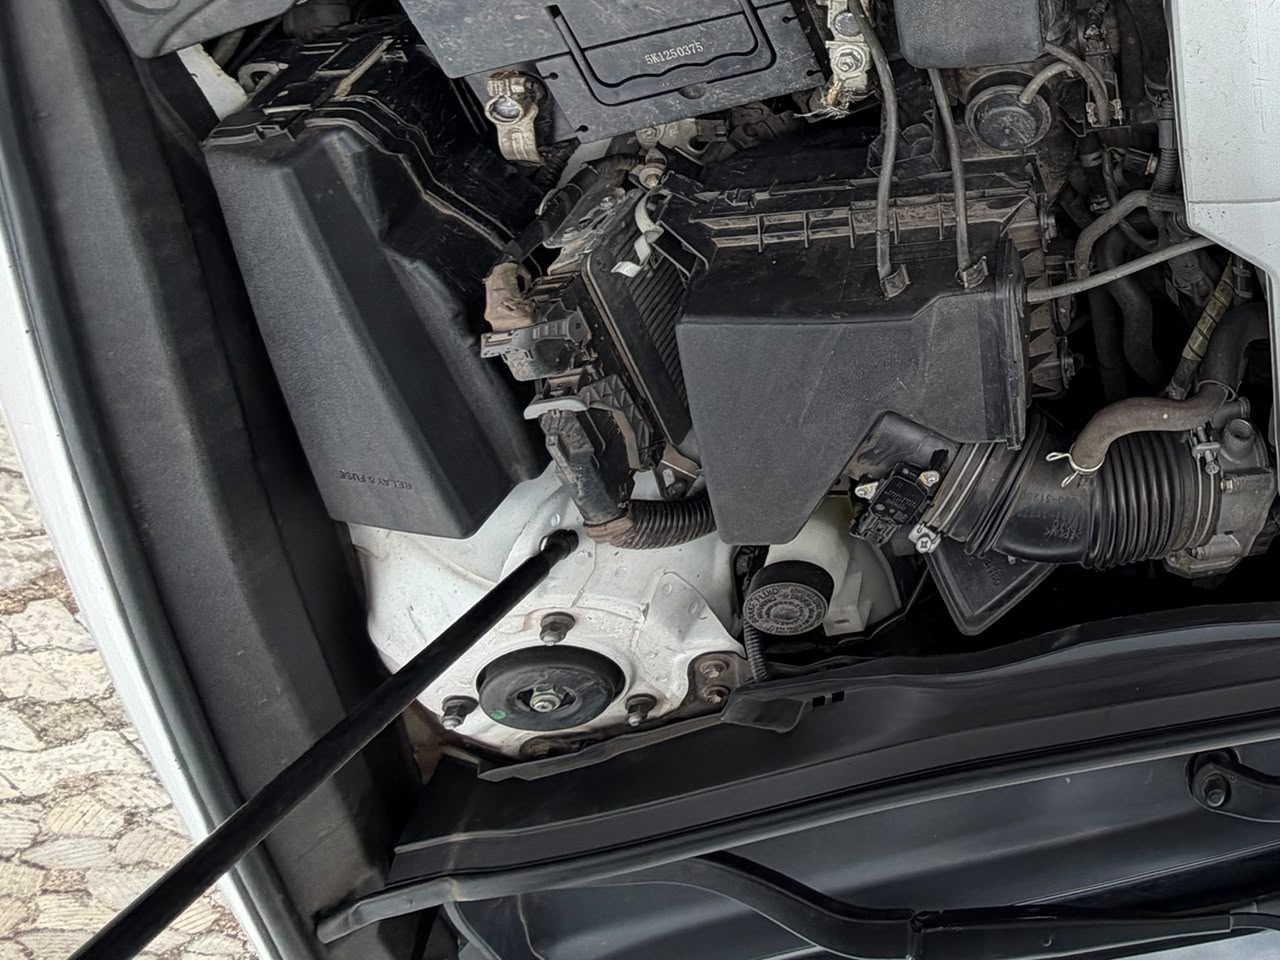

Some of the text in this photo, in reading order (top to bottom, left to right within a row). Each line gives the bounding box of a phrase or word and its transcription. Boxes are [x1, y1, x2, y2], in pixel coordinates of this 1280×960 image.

[644, 42, 704, 65] 5K1250375
[338, 470, 366, 483] FUSE
[377, 477, 412, 490] RELAY
